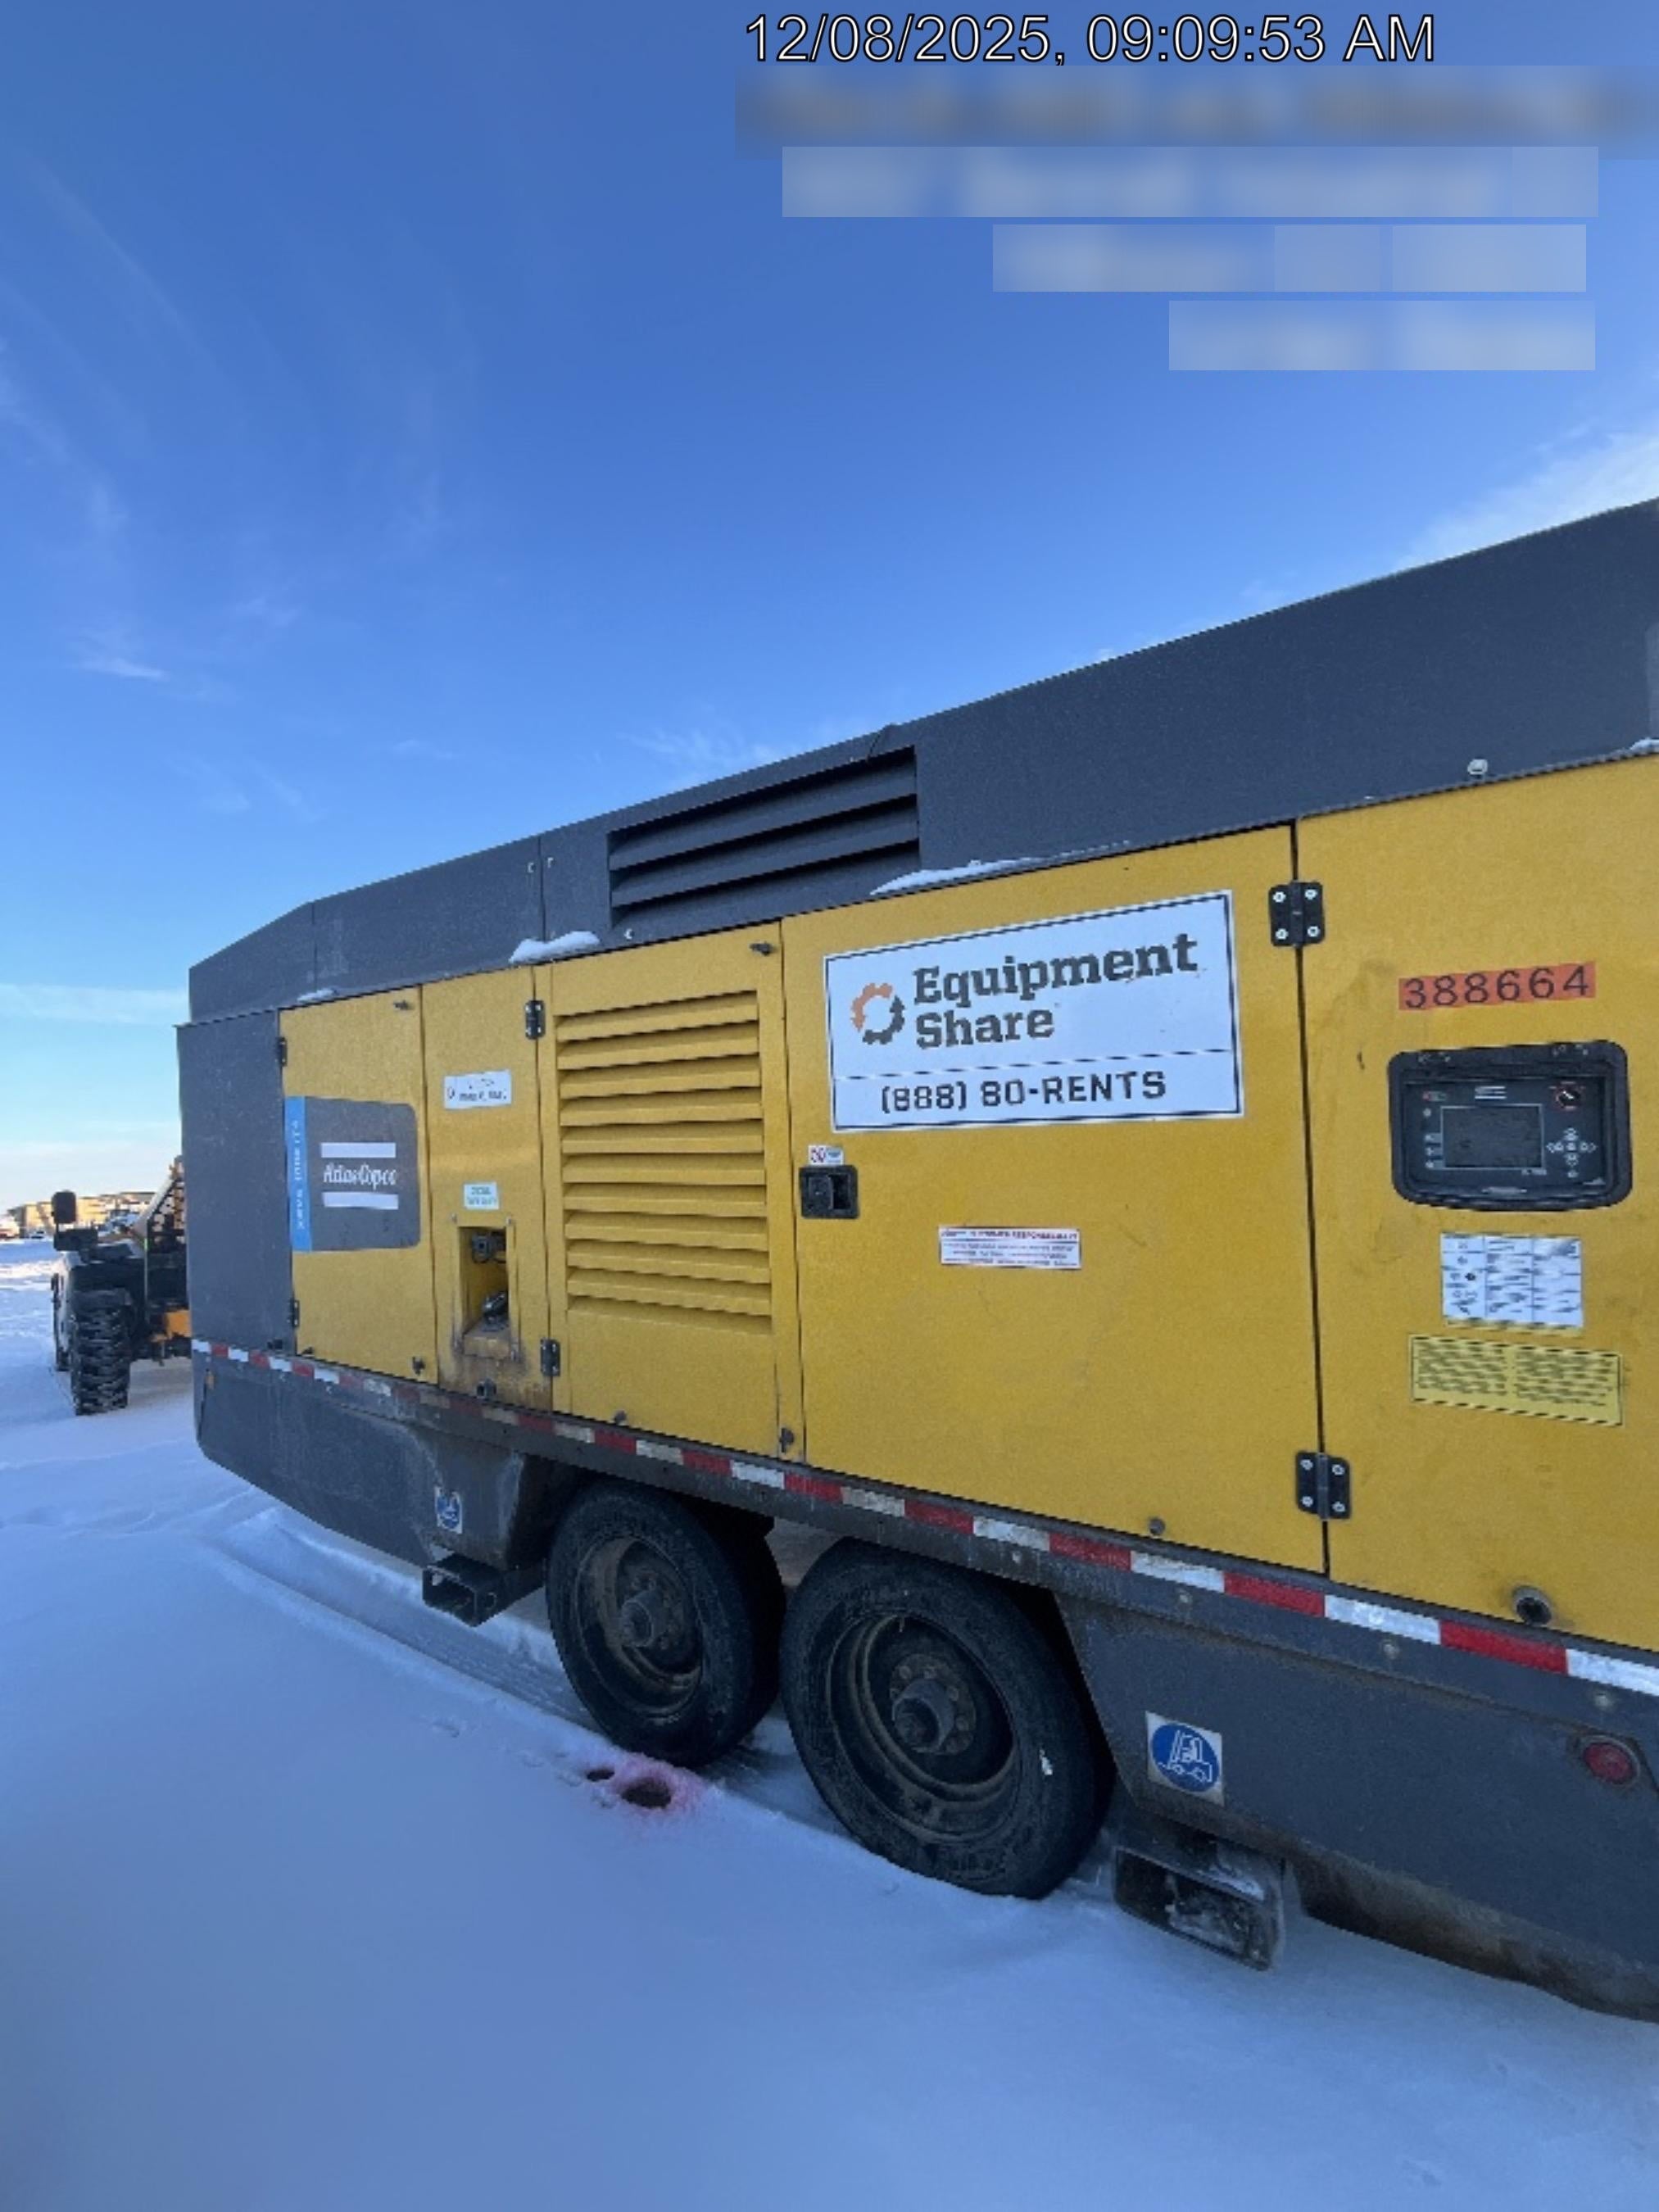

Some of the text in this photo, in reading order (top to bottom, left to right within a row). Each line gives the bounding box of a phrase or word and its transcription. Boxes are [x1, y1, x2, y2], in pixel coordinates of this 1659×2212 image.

[913, 933, 1198, 1007] Equipment
[1404, 966, 1589, 1009] 388664
[916, 1009, 1054, 1049] Share
[882, 1070, 1167, 1113] (888) 80-RENTS
